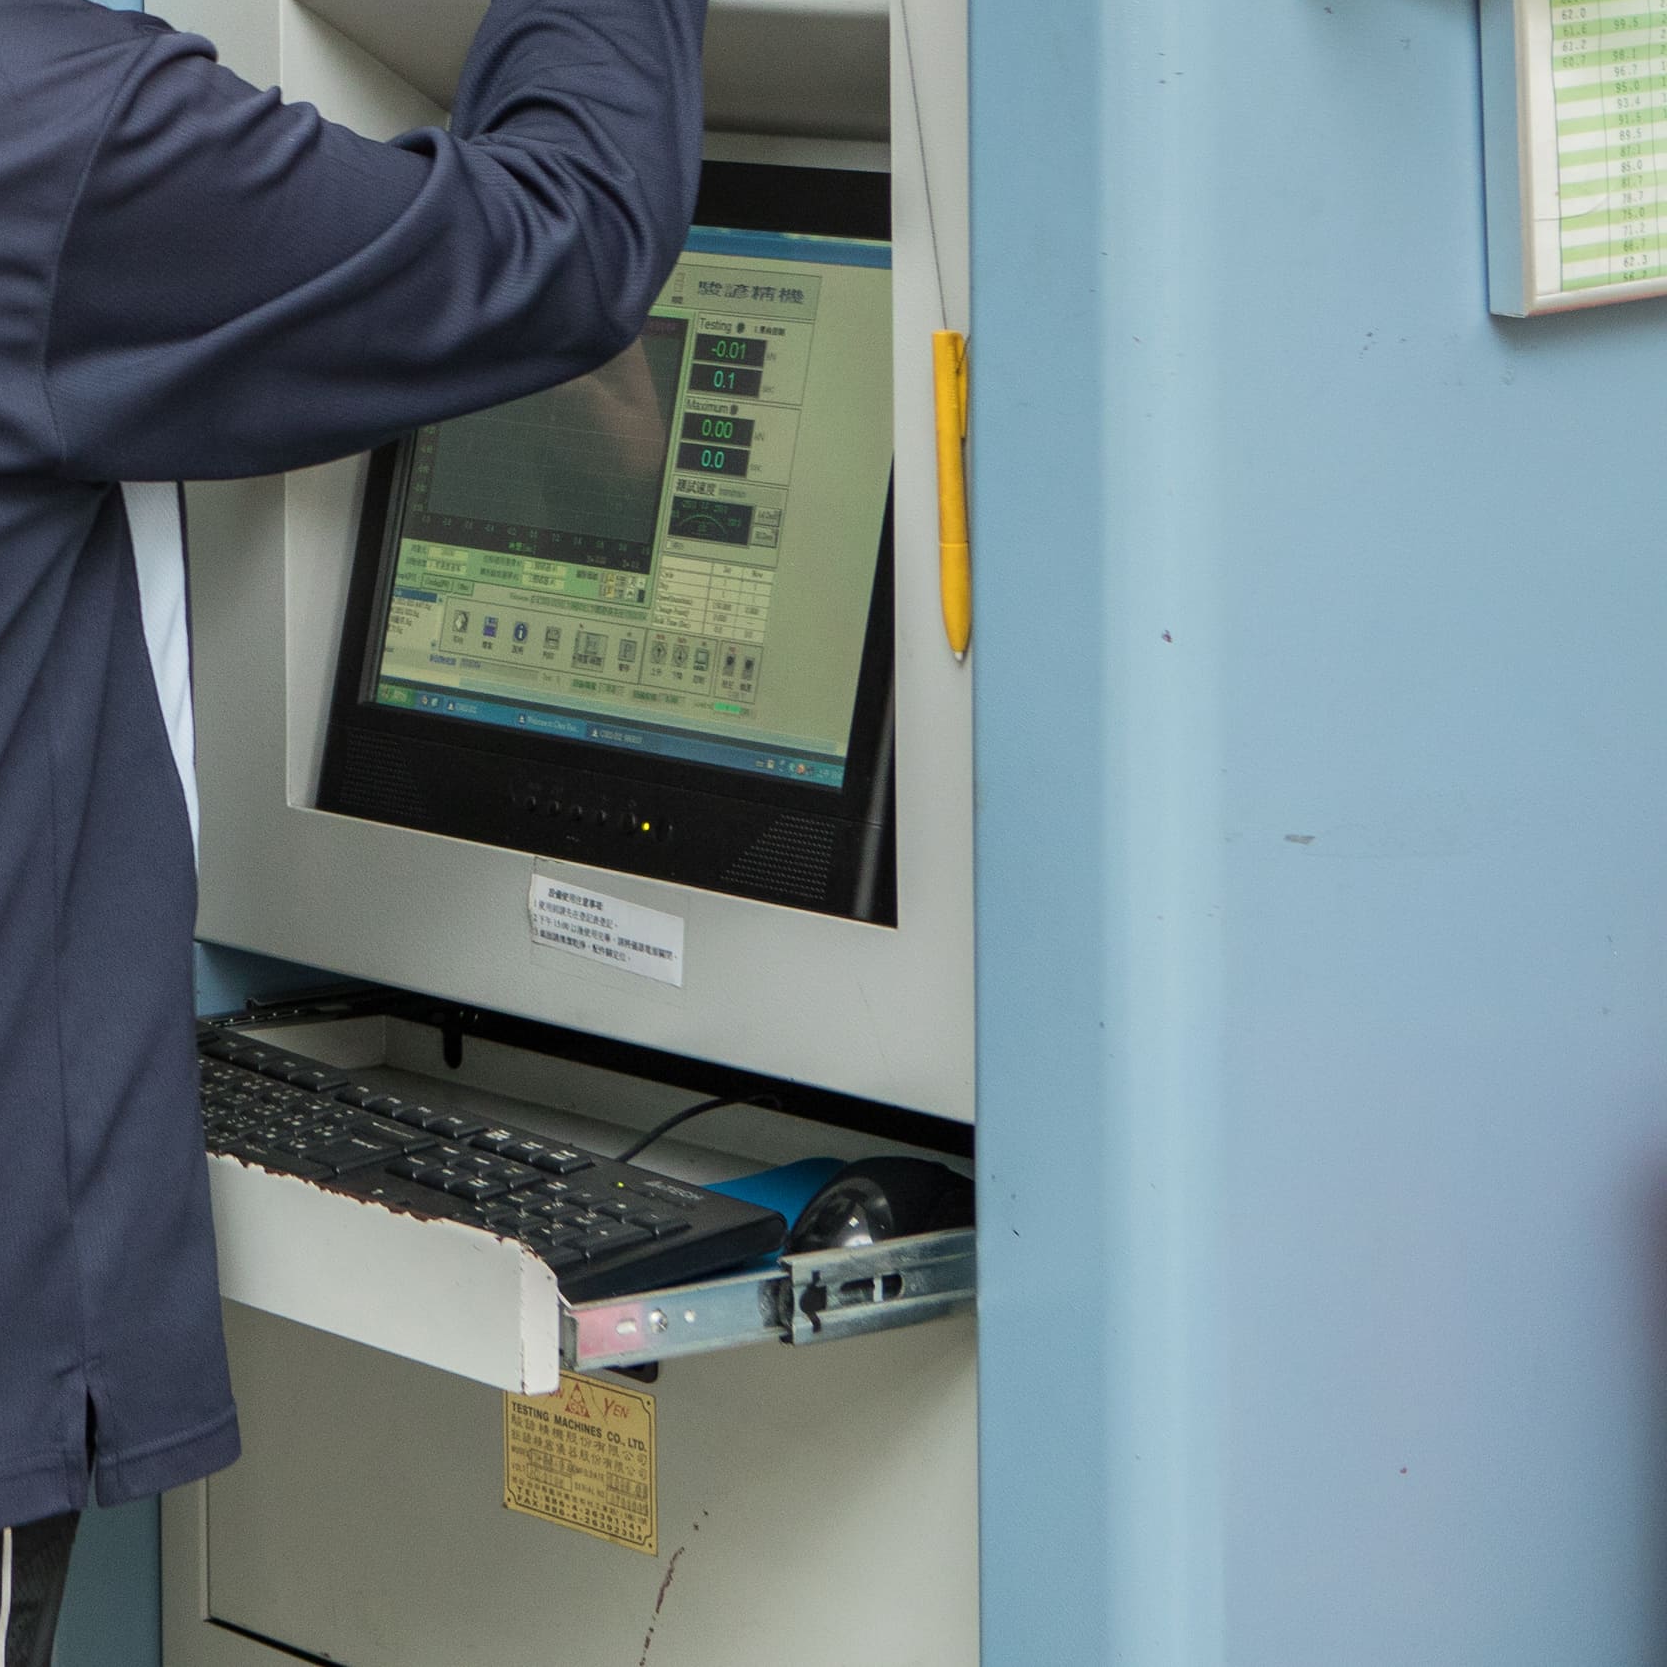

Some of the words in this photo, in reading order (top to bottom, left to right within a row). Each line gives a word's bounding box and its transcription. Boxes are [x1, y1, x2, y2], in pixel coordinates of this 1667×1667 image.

[1562, 7, 1587, 20] 62.0
[1614, 64, 1638, 77] 96.7
[1615, 80, 1640, 93] 95.0
[1621, 160, 1643, 173] 85.0
[1623, 222, 1645, 236] 71.2
[1623, 254, 1648, 268] 62.3
[698, 280, 805, 305] 駿諺精機
[699, 317, 732, 334] Testing
[711, 340, 748, 360] -0.01
[713, 370, 736, 389] 0.1
[686, 399, 729, 414] Maximum
[701, 419, 734, 439] 0.00
[701, 449, 725, 469] 0.0
[511, 1401, 549, 1422] TESTING
[554, 1414, 603, 1438] MACHINES
